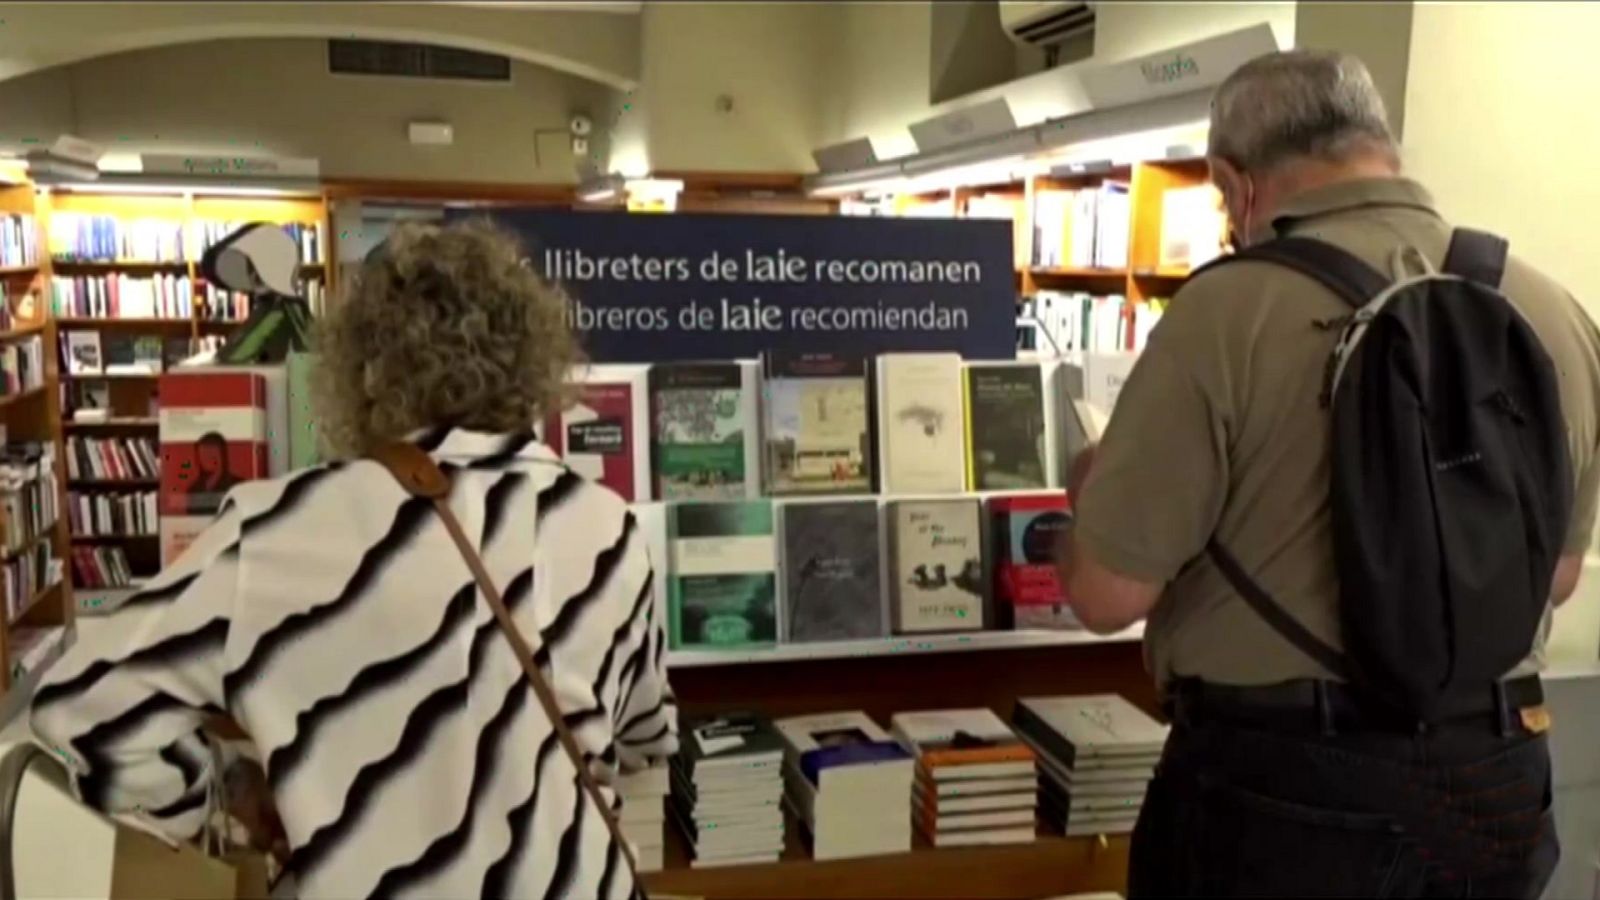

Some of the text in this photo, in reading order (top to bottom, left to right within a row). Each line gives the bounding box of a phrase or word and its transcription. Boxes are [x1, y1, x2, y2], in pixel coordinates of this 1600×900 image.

[544, 249, 690, 281] llibreters
[699, 250, 739, 281] de
[746, 248, 808, 282] laie
[815, 259, 982, 284] recomanen
[562, 297, 969, 331] ibreros de laie recomiendan
